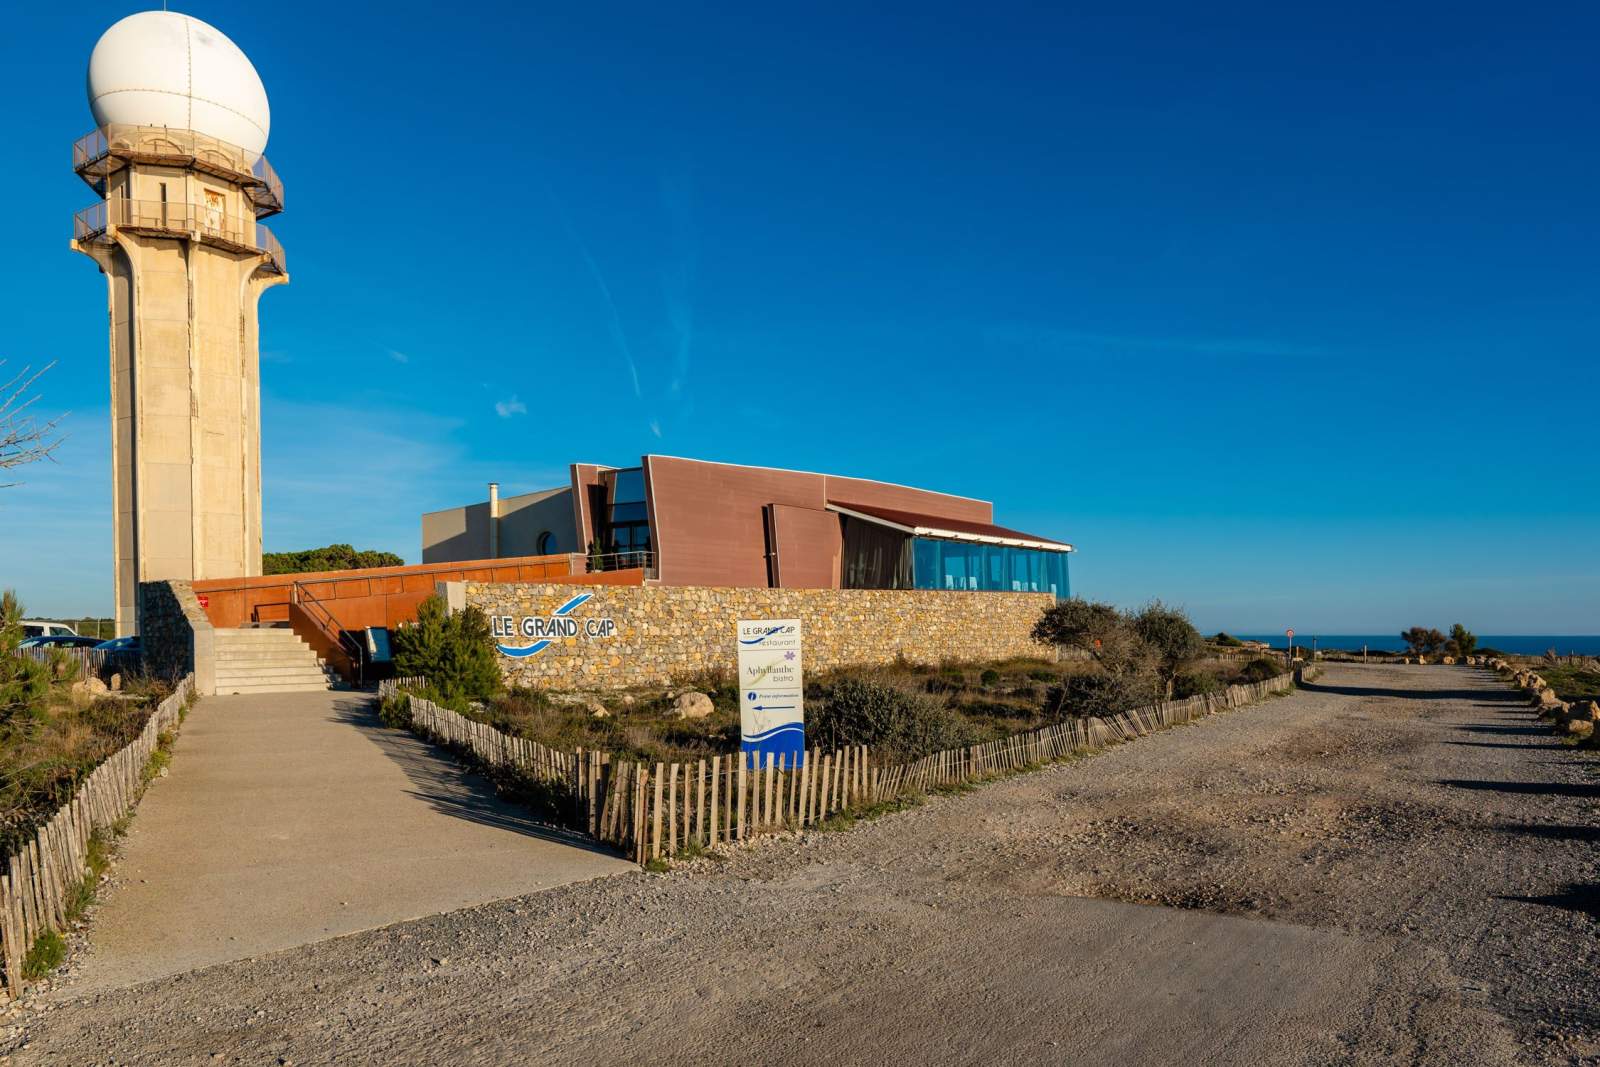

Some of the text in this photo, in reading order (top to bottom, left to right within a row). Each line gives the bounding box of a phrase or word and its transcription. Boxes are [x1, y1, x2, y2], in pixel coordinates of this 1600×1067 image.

[492, 616, 616, 637] LE GRAND CAP
[743, 627, 751, 635] LE
[781, 626, 796, 634] CAP
